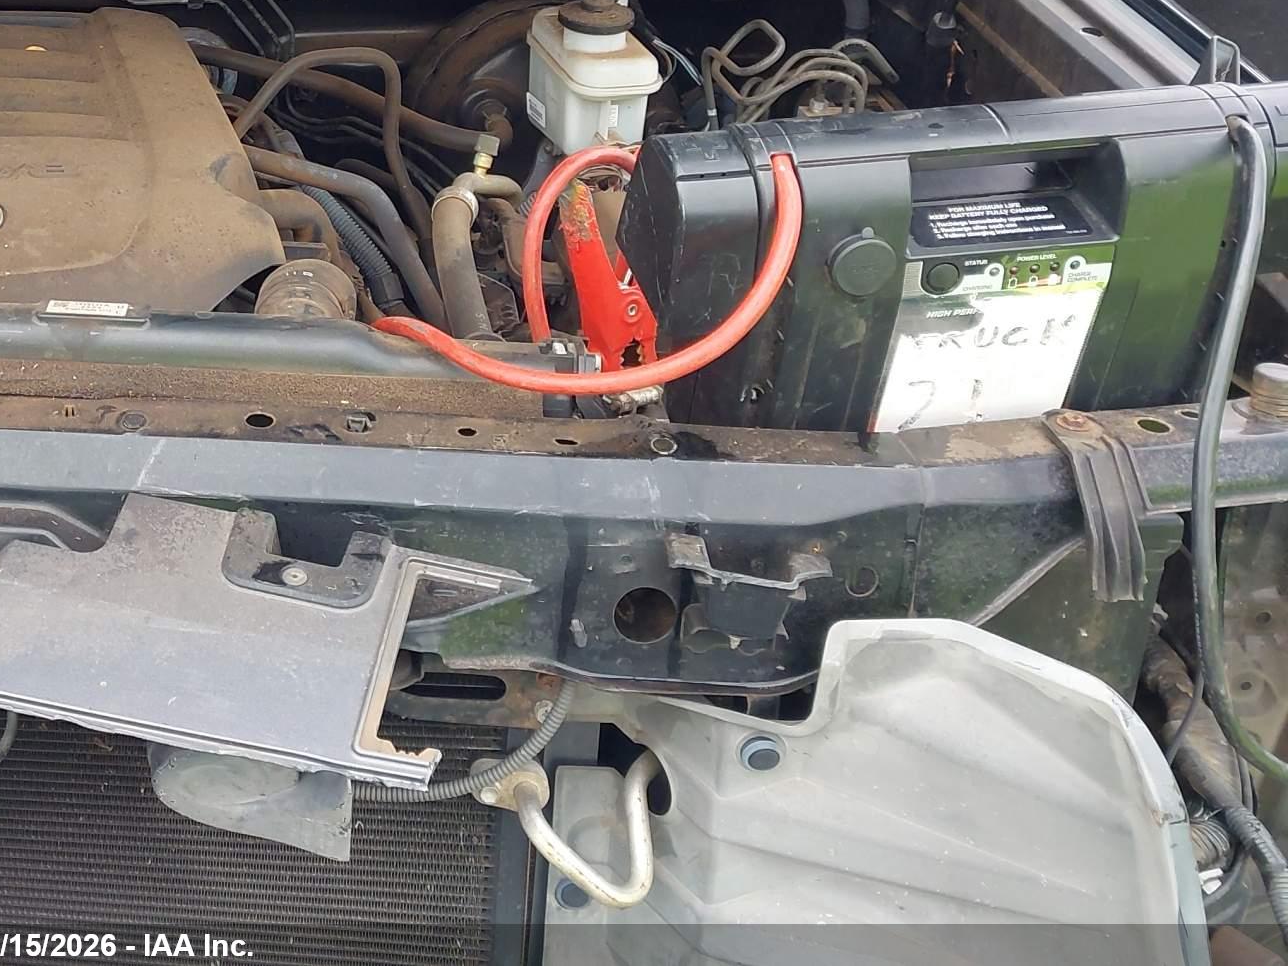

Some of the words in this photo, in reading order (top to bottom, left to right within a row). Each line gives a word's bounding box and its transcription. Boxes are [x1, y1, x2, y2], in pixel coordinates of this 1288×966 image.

[951, 210, 985, 219] BATTERY
[1010, 206, 1048, 214] CHARGED
[926, 309, 952, 318] HIGH
